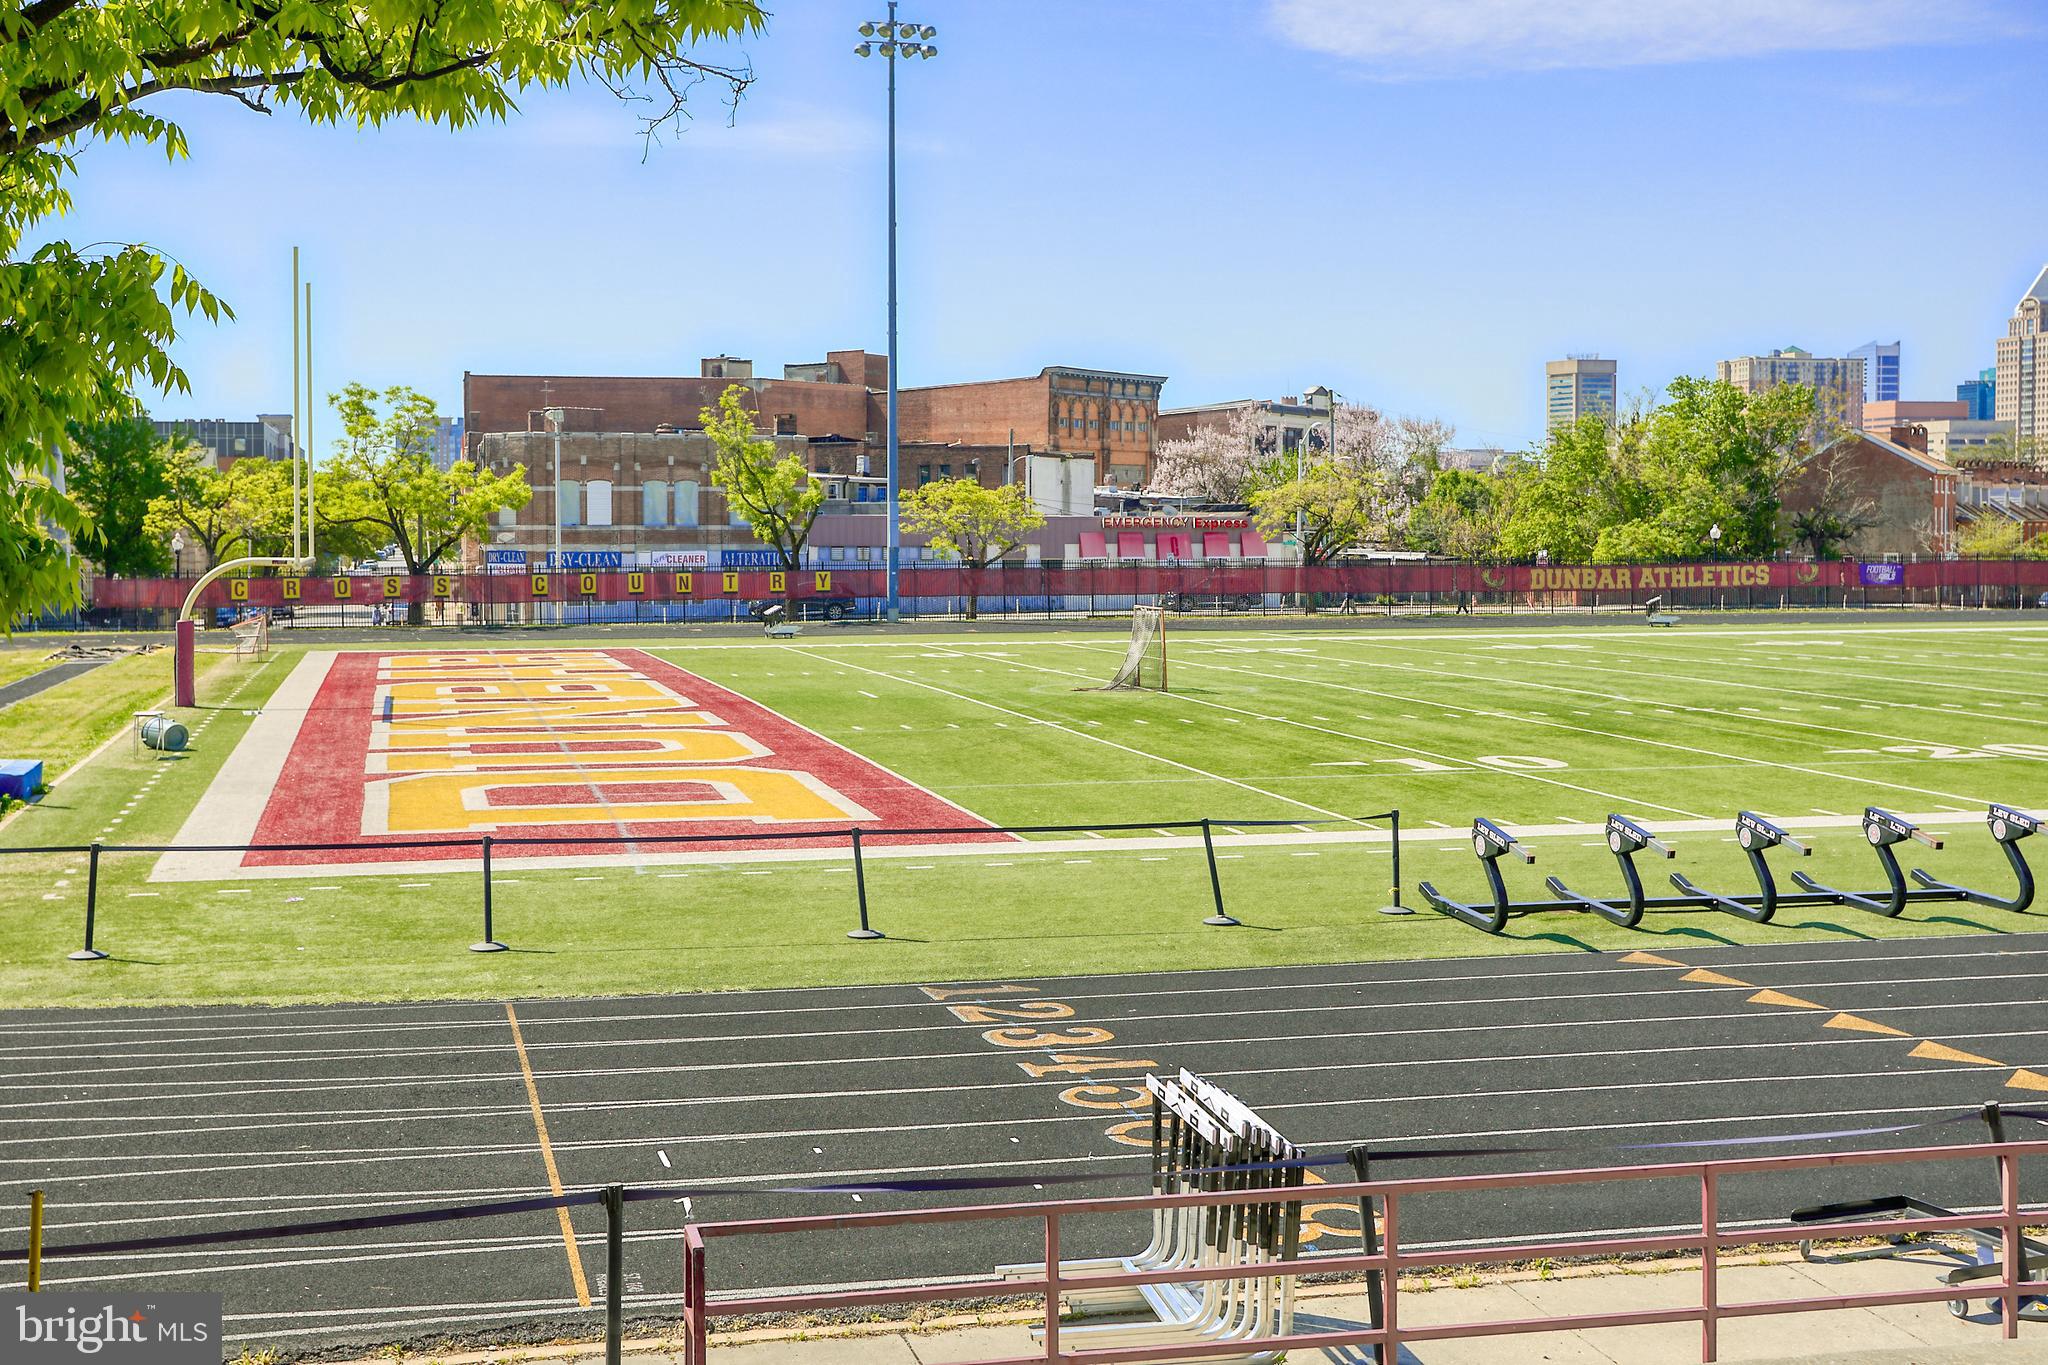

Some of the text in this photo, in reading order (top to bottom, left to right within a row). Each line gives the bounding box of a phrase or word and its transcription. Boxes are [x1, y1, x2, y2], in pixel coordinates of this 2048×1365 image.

[1102, 517, 1249, 531] EMERGENCY Express
[488, 551, 526, 563] DRY-CLEAN
[666, 554, 706, 564] CLEANER
[1530, 564, 1770, 590] DUNBAR ATHLETICS
[1866, 565, 1897, 574] FOOTBALL
[1741, 815, 1776, 839] LEV SLD
[1993, 807, 2031, 828] LEV SLED
[945, 1002, 1076, 1023] 2
[981, 1026, 1116, 1048] 3
